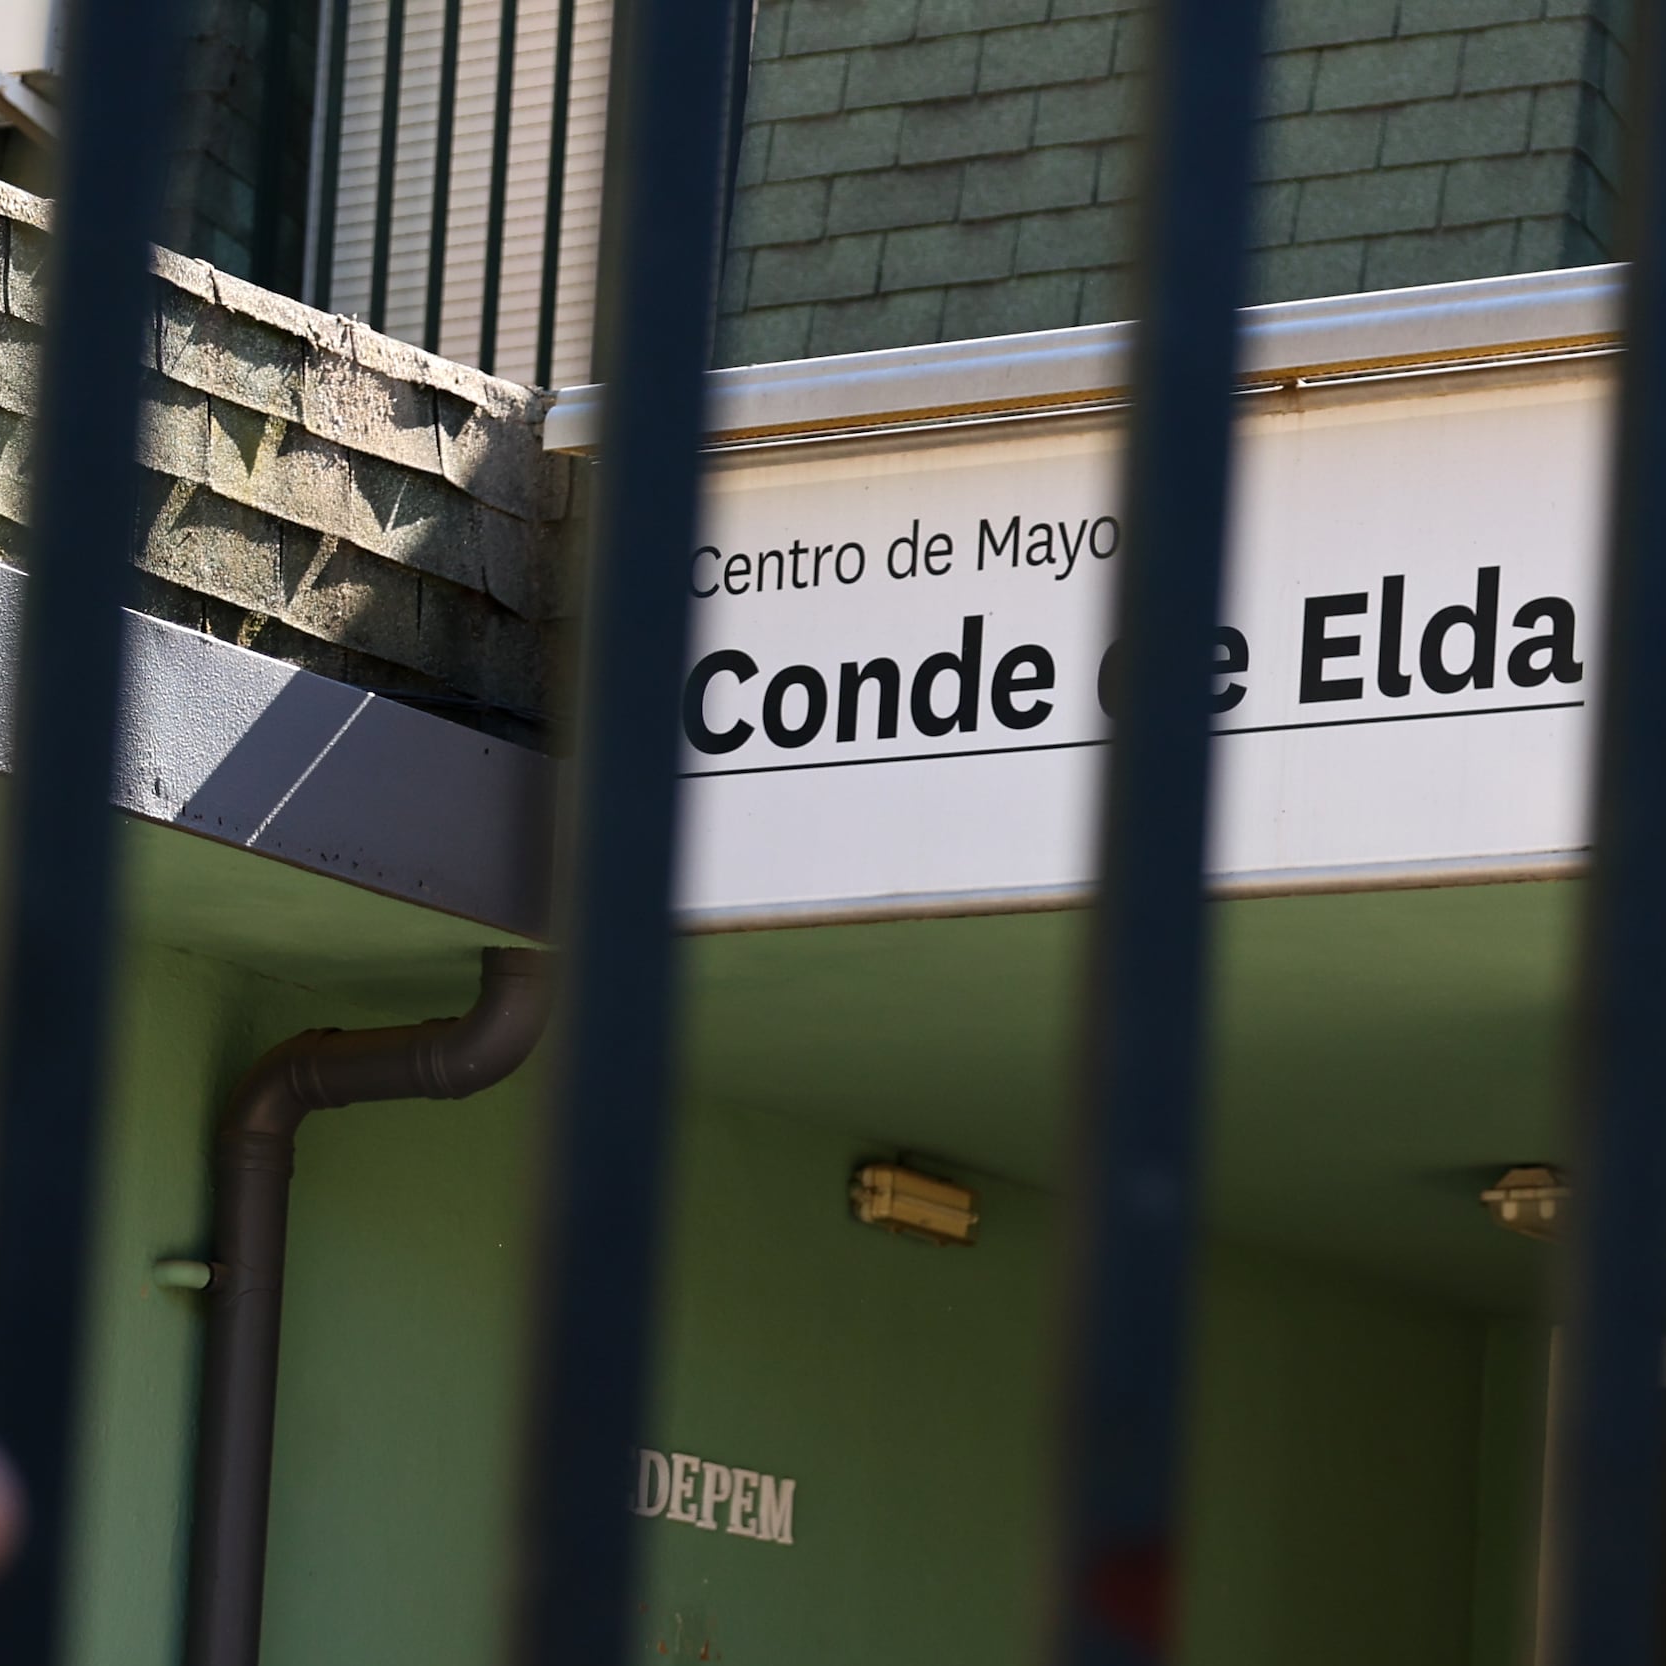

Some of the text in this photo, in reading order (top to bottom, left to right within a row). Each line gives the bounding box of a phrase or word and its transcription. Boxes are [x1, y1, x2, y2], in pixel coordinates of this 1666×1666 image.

[689, 514, 1121, 599] Centro de Mayo
[682, 614, 1056, 755] Conde
[1298, 565, 1584, 705] Elda
[633, 1448, 796, 1545] DEPEM
